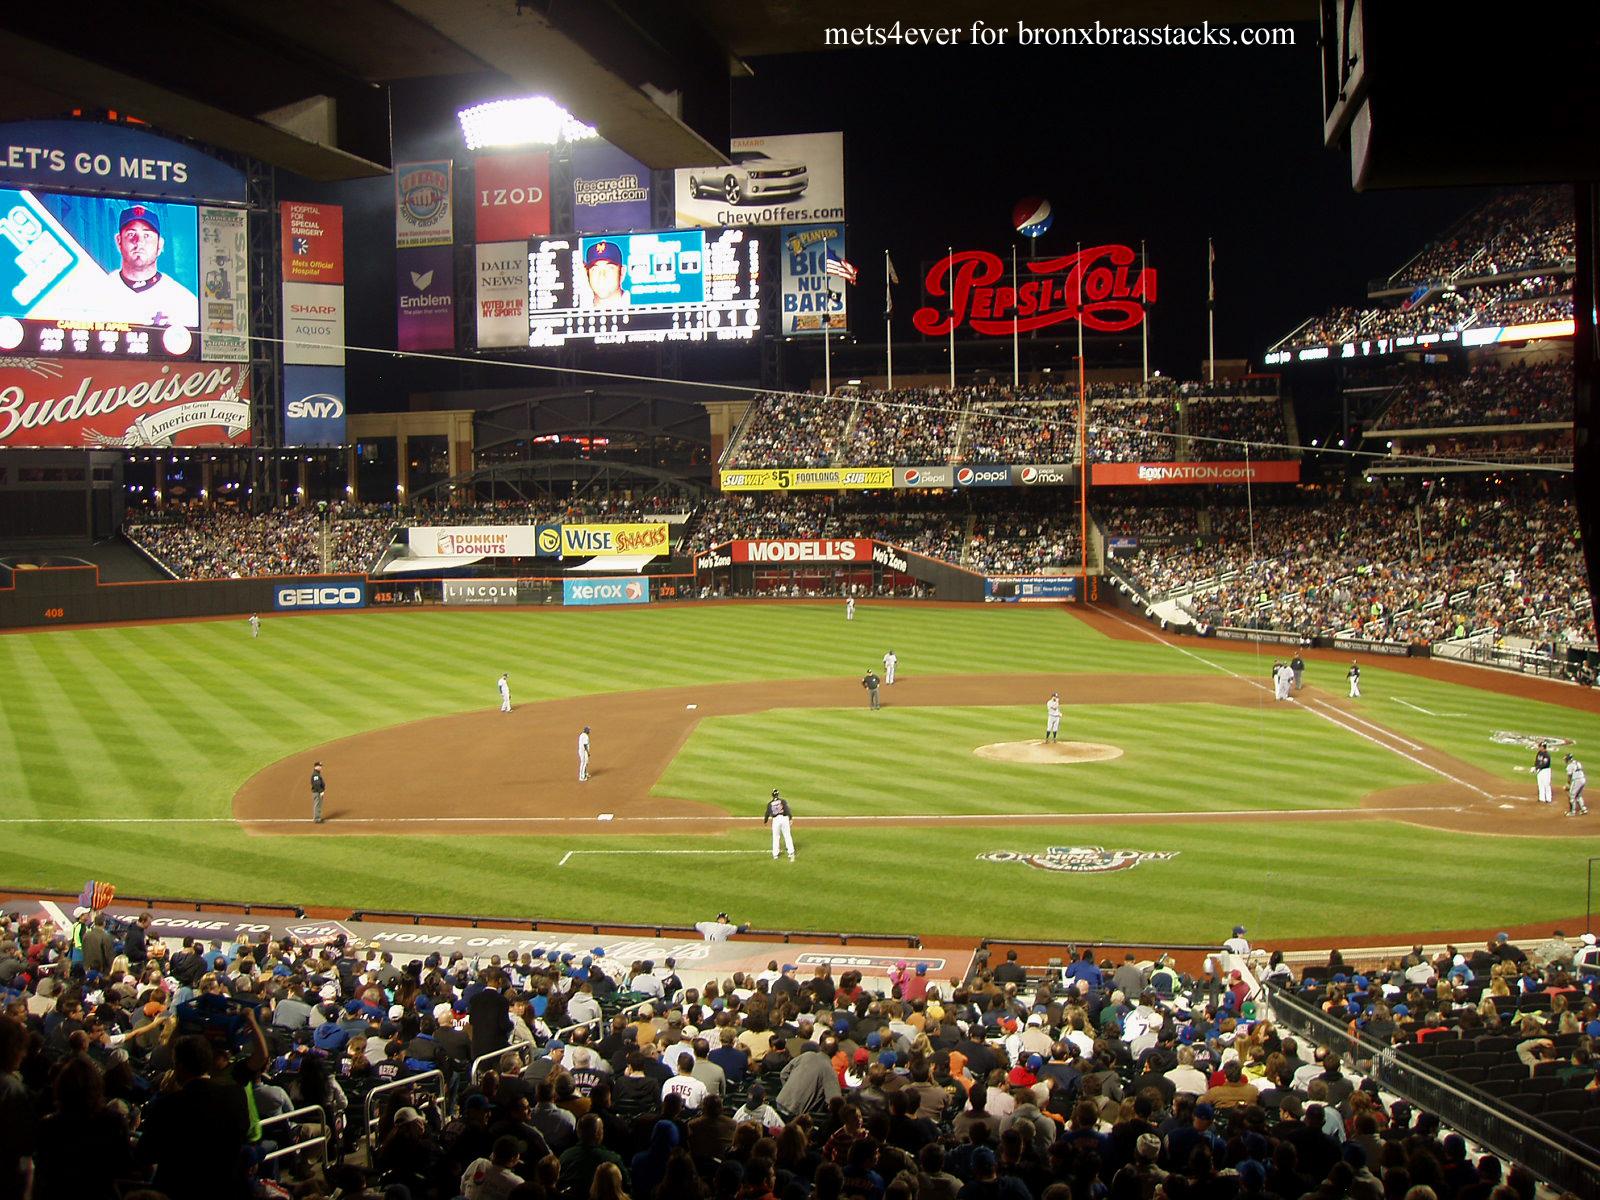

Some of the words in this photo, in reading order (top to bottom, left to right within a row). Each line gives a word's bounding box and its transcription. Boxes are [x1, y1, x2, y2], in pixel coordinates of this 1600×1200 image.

[75, 152, 111, 175] GO
[120, 156, 188, 183] METS
[575, 174, 638, 193] freecredit
[481, 187, 543, 207] IZOD
[290, 205, 320, 214] HOSPITAL
[717, 206, 844, 224] ChevyOffers.com
[291, 220, 320, 229] SPECIAL
[291, 228, 324, 236] SURGERY
[291, 260, 309, 268] Mets
[310, 261, 335, 271] Official
[291, 267, 321, 276] Hospital
[481, 261, 523, 271] DAILY
[235, 232, 247, 332] SALES
[482, 276, 523, 286] NEWS
[798, 276, 832, 292] NUT
[400, 294, 452, 308] Emblem
[481, 300, 504, 309] VOTED
[290, 304, 337, 315] SHARP
[494, 308, 522, 317] SPORTS
[295, 326, 332, 336] AQUOS
[0, 366, 233, 440] Budweiser
[287, 400, 336, 419] SNY
[151, 413, 207, 438] American
[210, 408, 246, 423] Lager
[723, 472, 771, 487] SUBWAY
[772, 470, 790, 488] $5
[796, 471, 840, 484] FOOTLONGS
[842, 471, 891, 486] SUBWAY
[921, 474, 945, 483] pepsi
[975, 469, 1008, 483] pepsi
[1038, 473, 1064, 483] max
[1137, 465, 1256, 481] FOXNATION.com
[456, 534, 508, 544] DUNKIN'
[566, 529, 612, 550] WISE
[615, 527, 667, 553] SNACKS
[456, 545, 506, 554] DONUTS
[748, 541, 856, 562] MODELL'S
[713, 554, 731, 567] Zone
[888, 553, 908, 573] Zone
[278, 587, 361, 607] GEICO
[374, 592, 392, 603] 415
[450, 586, 518, 598] LINCOLN
[572, 582, 622, 600] xerox
[44, 607, 64, 618] 408
[111, 914, 230, 930] ECOME
[234, 922, 271, 934] TO
[372, 931, 462, 945] HOME
[467, 936, 511, 948] OF
[671, 1084, 692, 1097] REYES
